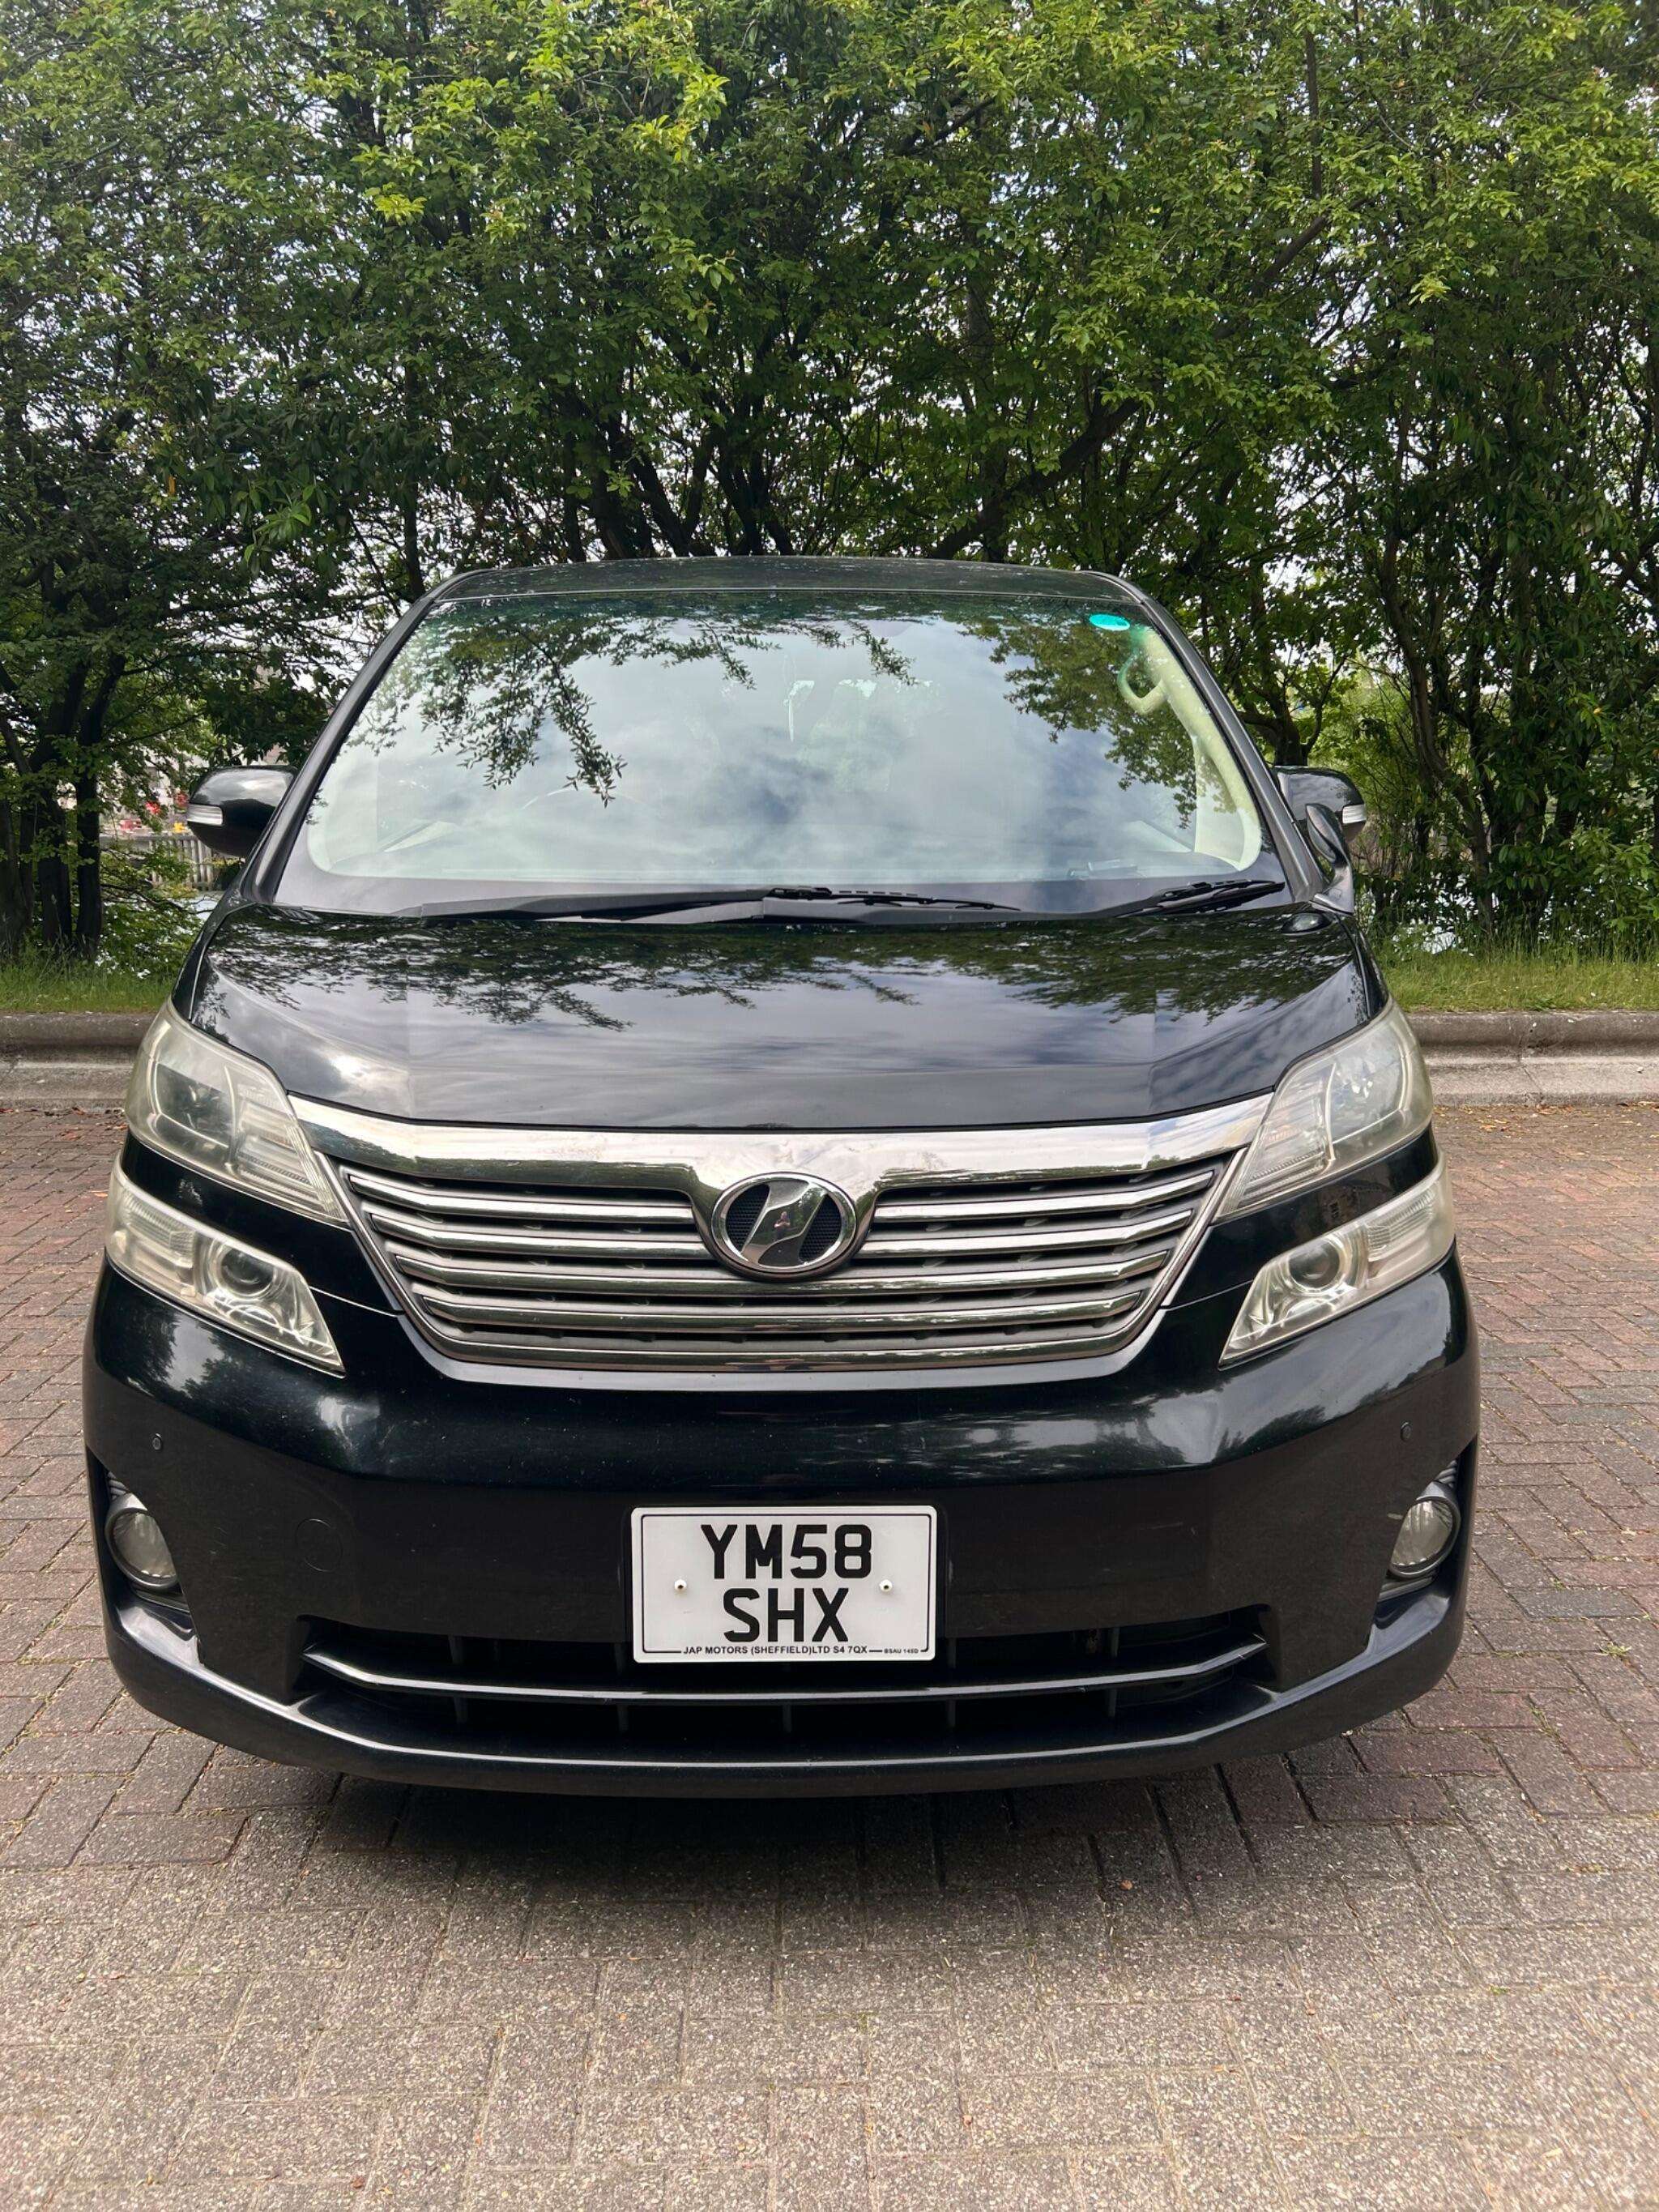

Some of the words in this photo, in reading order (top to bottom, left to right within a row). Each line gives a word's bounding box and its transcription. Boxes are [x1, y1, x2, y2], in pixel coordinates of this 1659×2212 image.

[700, 1524, 872, 1579] YM58
[723, 1587, 849, 1642] SHX
[683, 1646, 702, 1655] JAP
[706, 1646, 748, 1655] MOTORS
[833, 1646, 845, 1654] S4
[848, 1646, 868, 1654] 7QX
